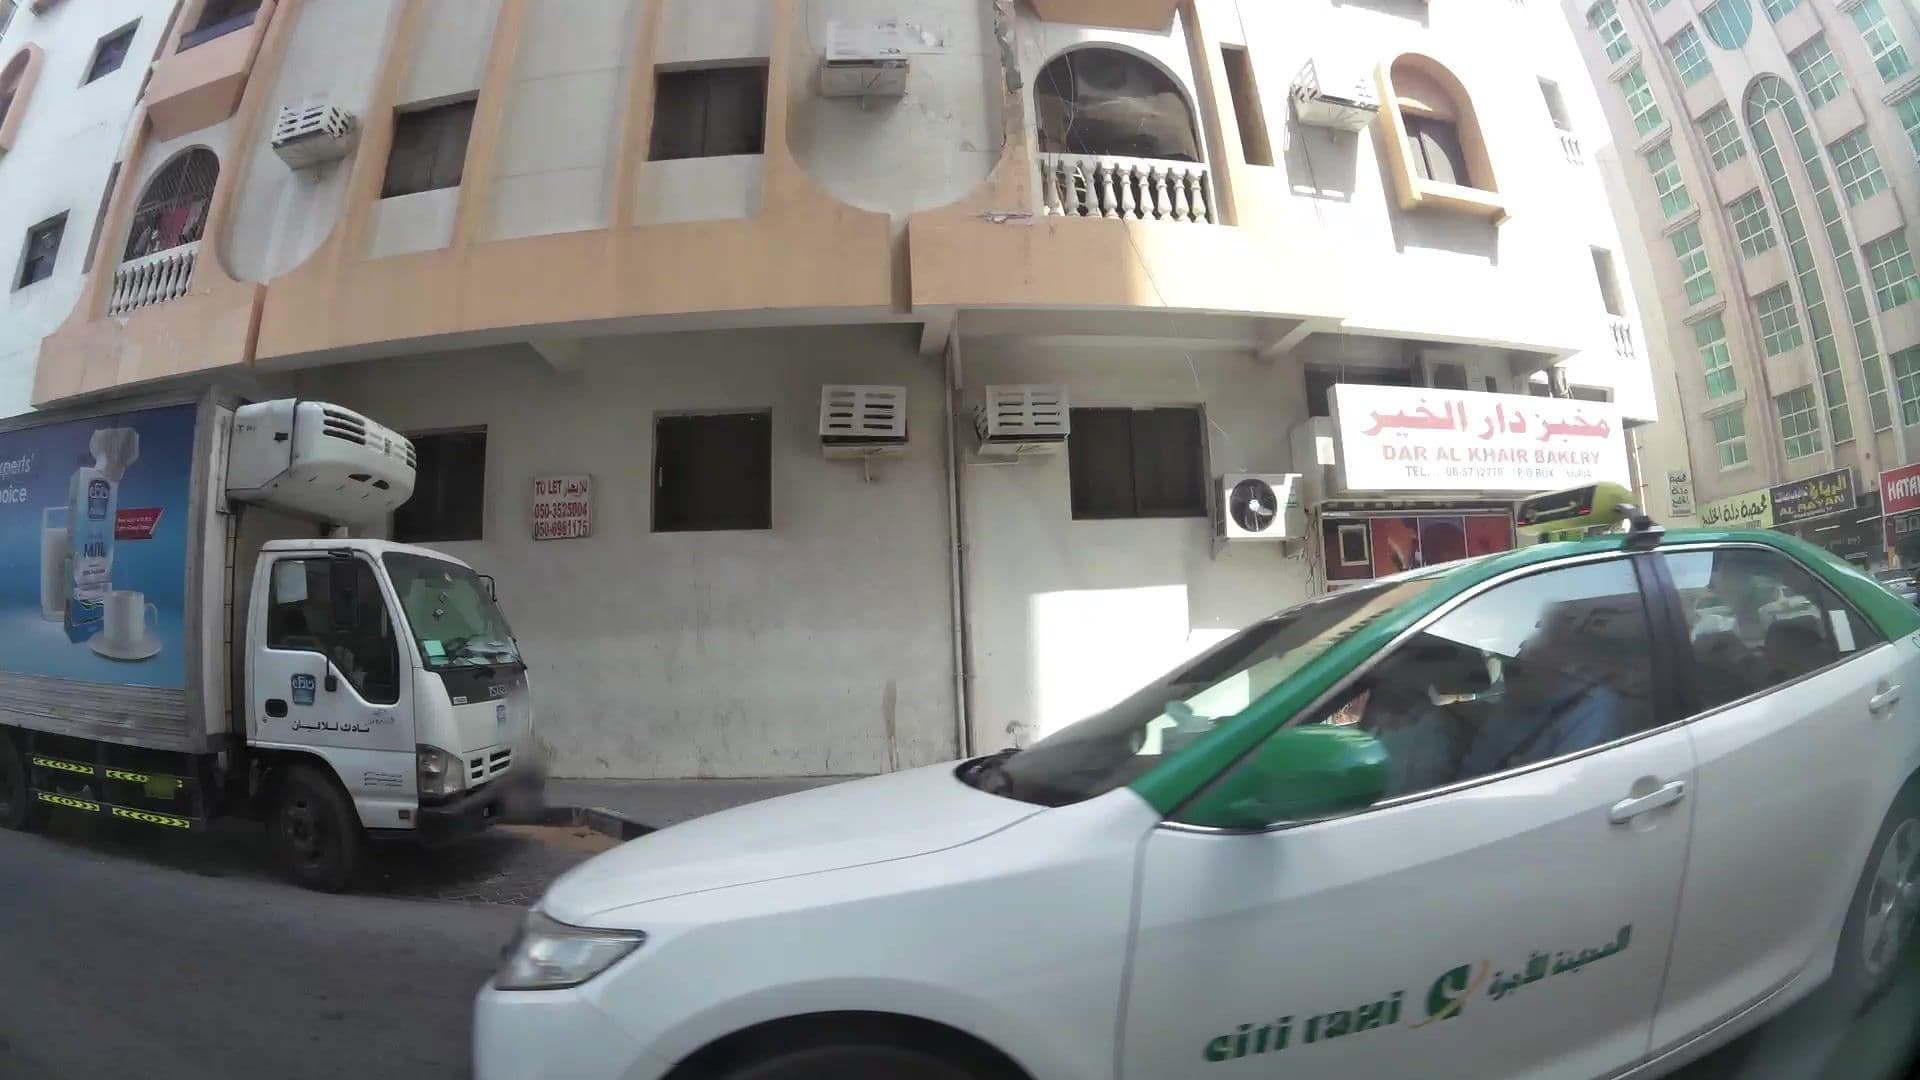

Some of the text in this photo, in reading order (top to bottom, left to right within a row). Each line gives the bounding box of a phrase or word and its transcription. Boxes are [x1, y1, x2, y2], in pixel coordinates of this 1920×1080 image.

[1360, 398, 1610, 442] مخبز دار الخير
[1382, 445, 1600, 464] DAR AL KHAIR BAKERY
[0, 484, 27, 504] oice
[535, 480, 546, 496] TO
